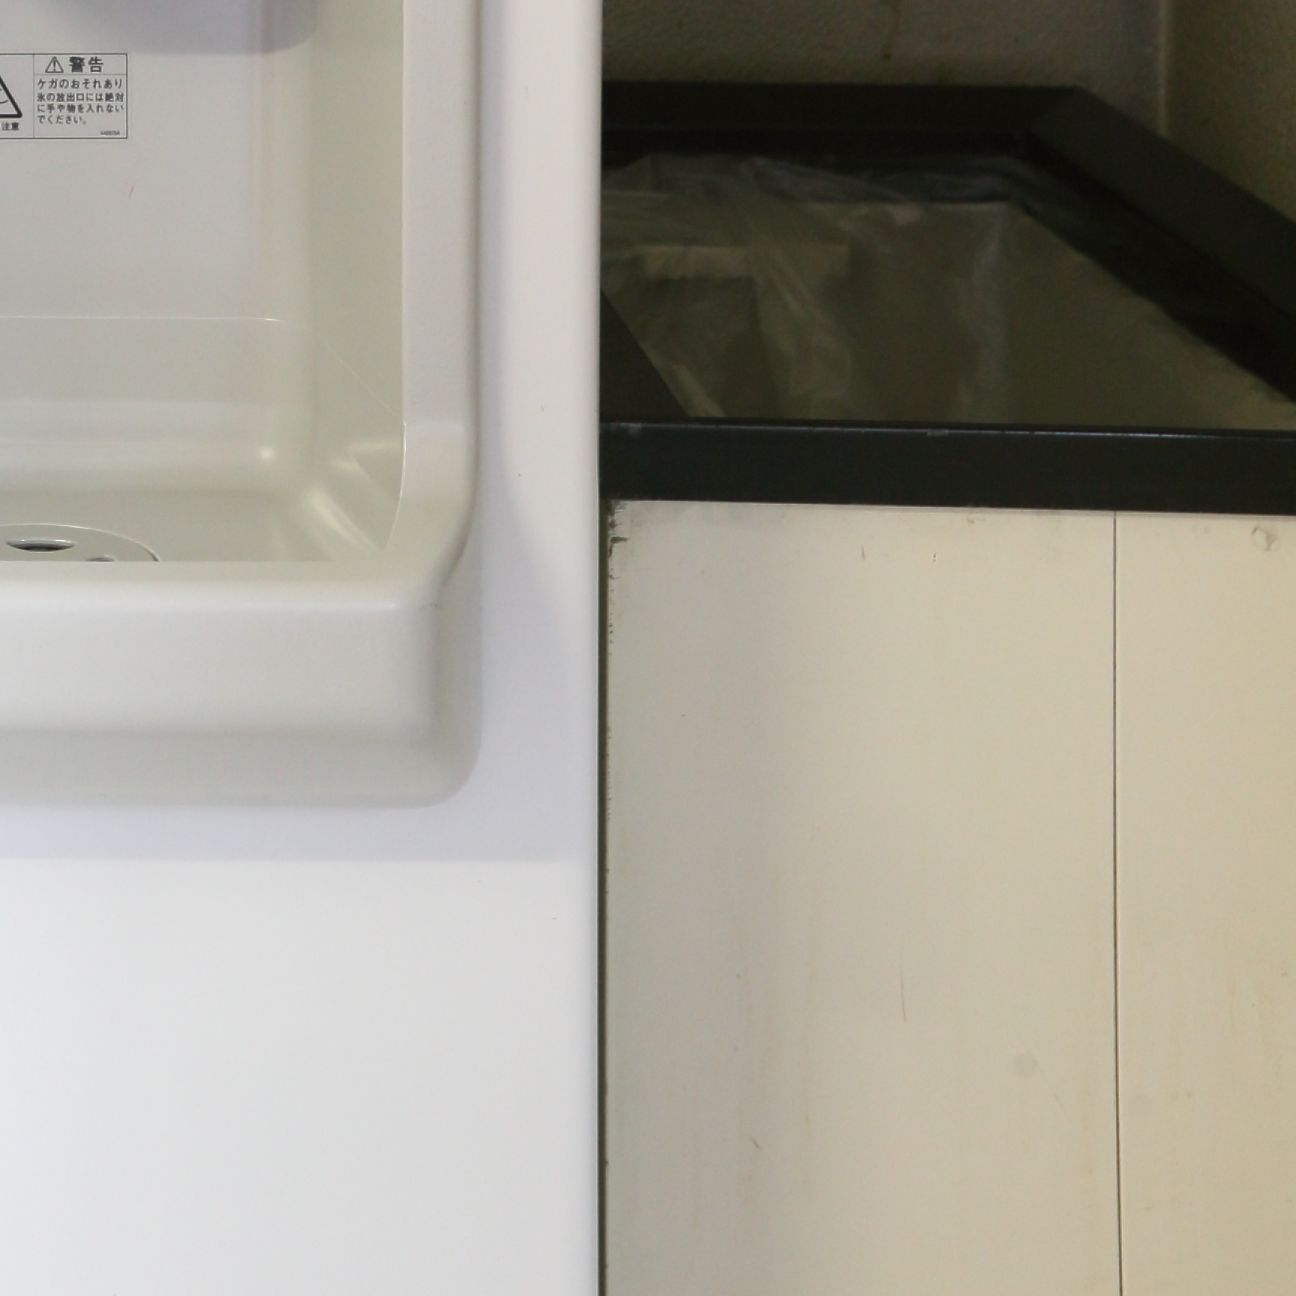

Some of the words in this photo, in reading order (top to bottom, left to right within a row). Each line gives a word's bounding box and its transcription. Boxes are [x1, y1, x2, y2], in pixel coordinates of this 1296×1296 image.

[69, 56, 104, 73] 警告
[37, 78, 123, 89] ケガのおそれあり
